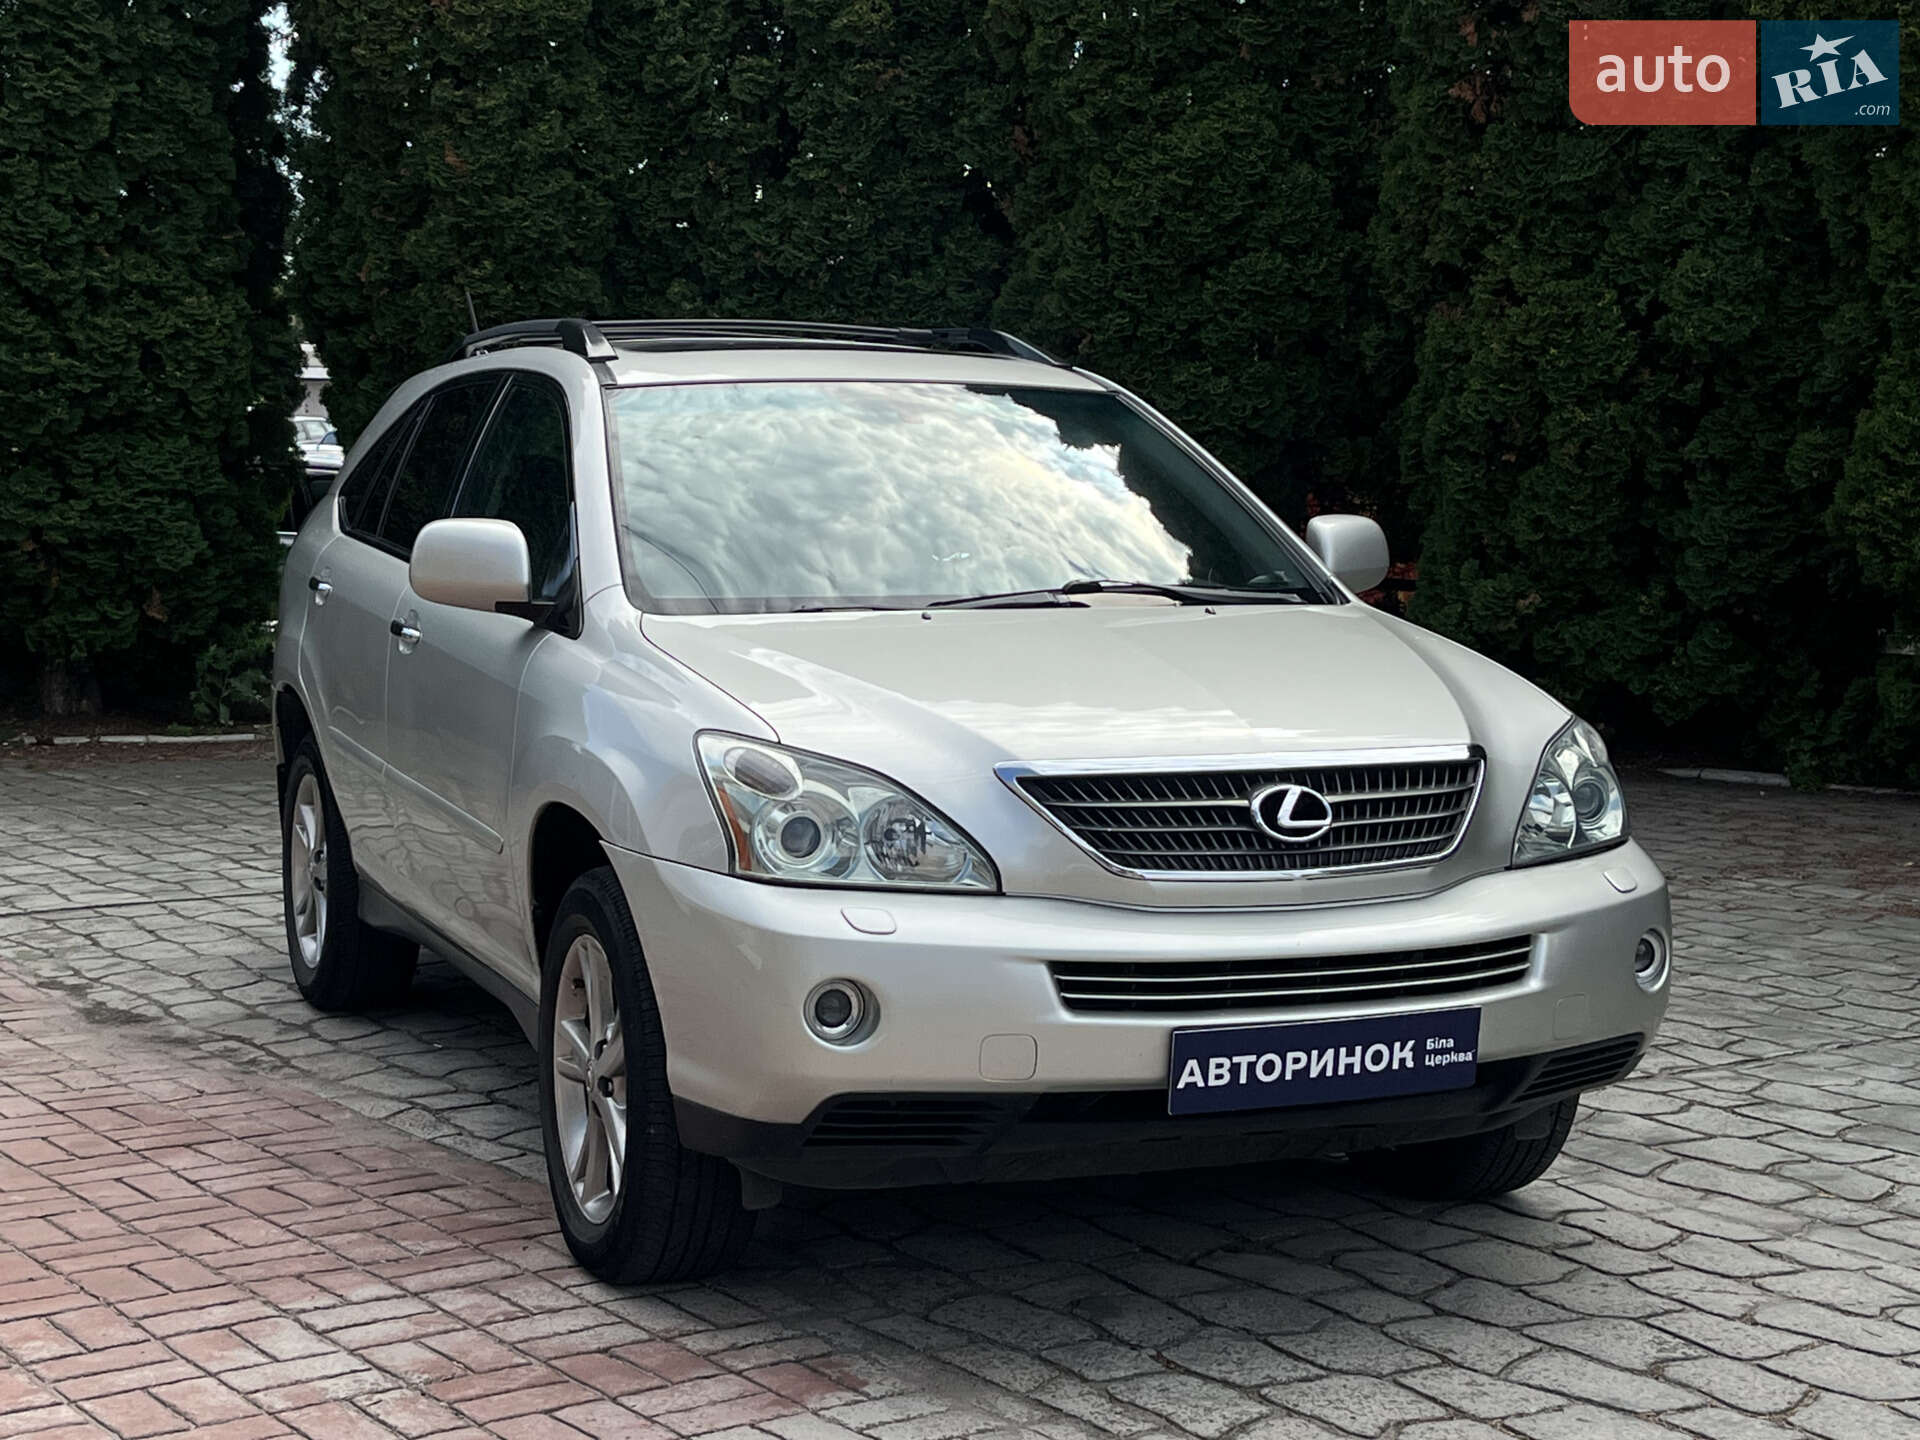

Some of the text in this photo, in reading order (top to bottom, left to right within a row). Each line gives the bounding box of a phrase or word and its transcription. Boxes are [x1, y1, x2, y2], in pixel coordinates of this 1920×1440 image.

[1425, 1036, 1455, 1050] Біла
[1176, 1040, 1416, 1089] АВТОРИНОК
[1424, 1050, 1474, 1067] Церква
